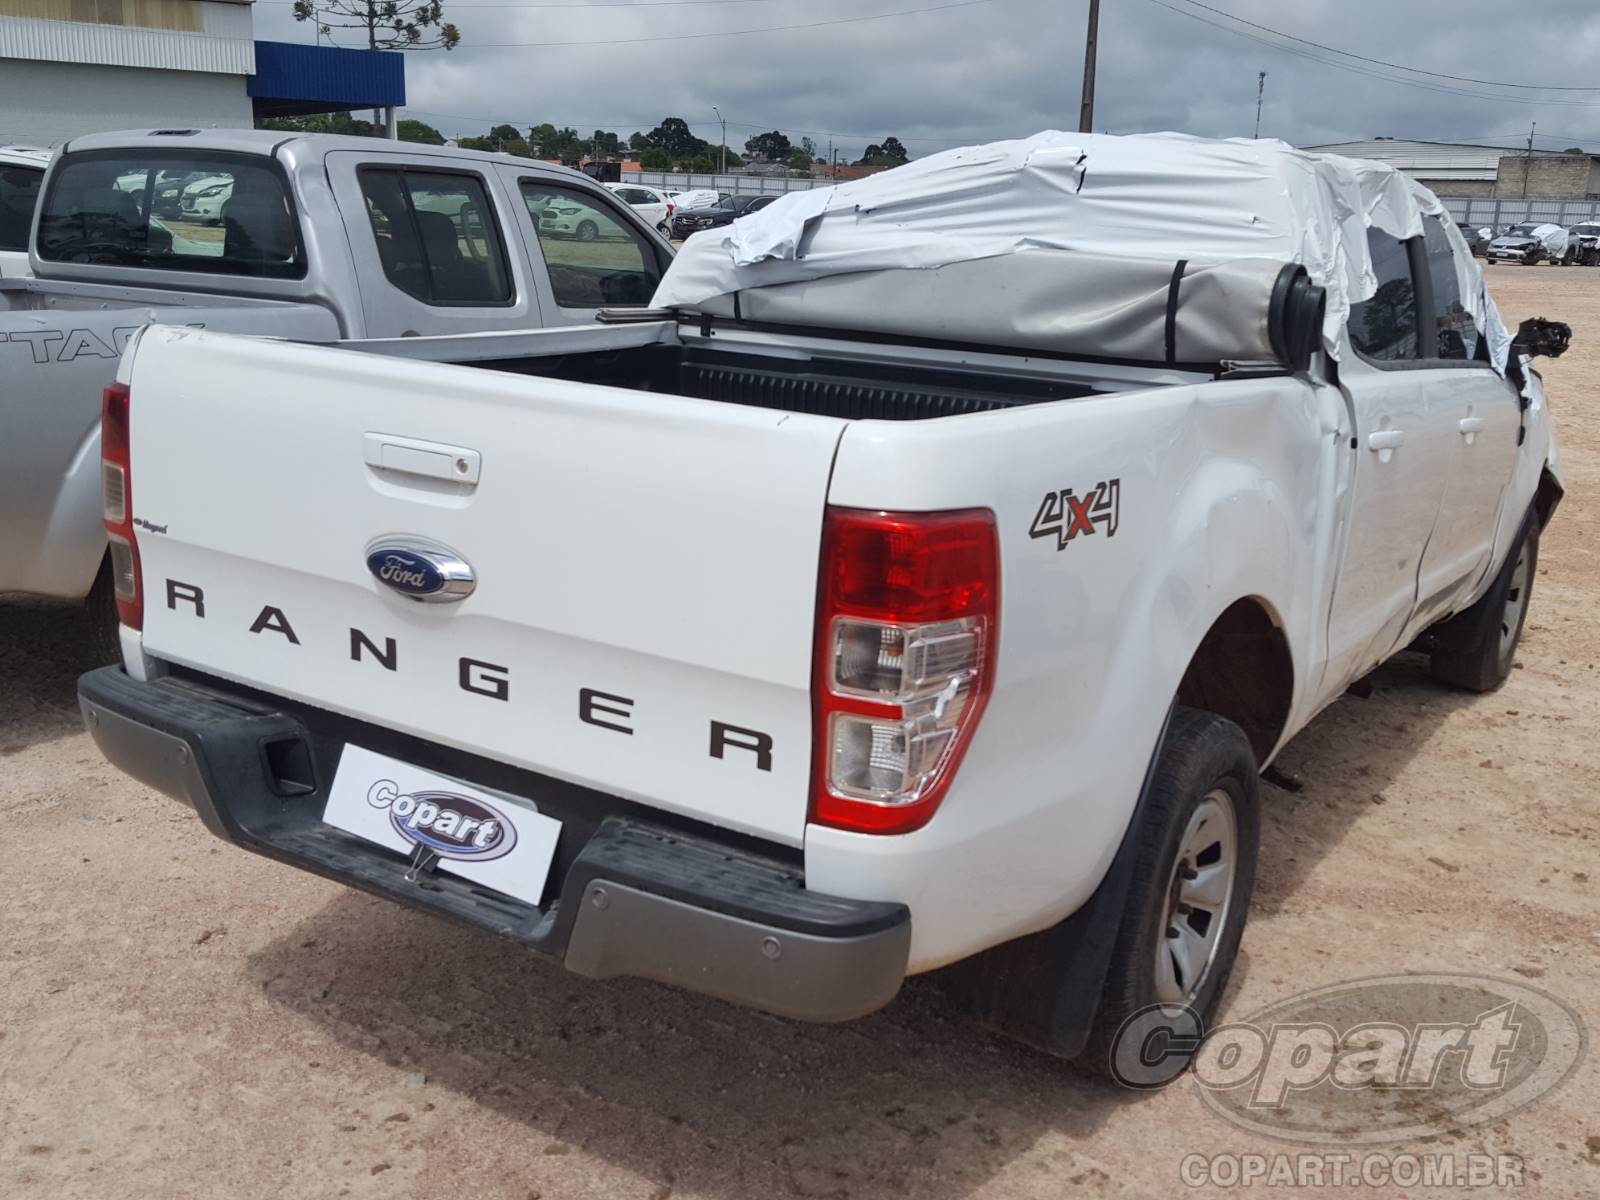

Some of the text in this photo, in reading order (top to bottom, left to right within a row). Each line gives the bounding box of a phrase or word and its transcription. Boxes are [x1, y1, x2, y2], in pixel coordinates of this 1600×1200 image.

[380, 554, 426, 587] Ford
[166, 578, 774, 772] RANGER
[367, 778, 498, 848] Copart
